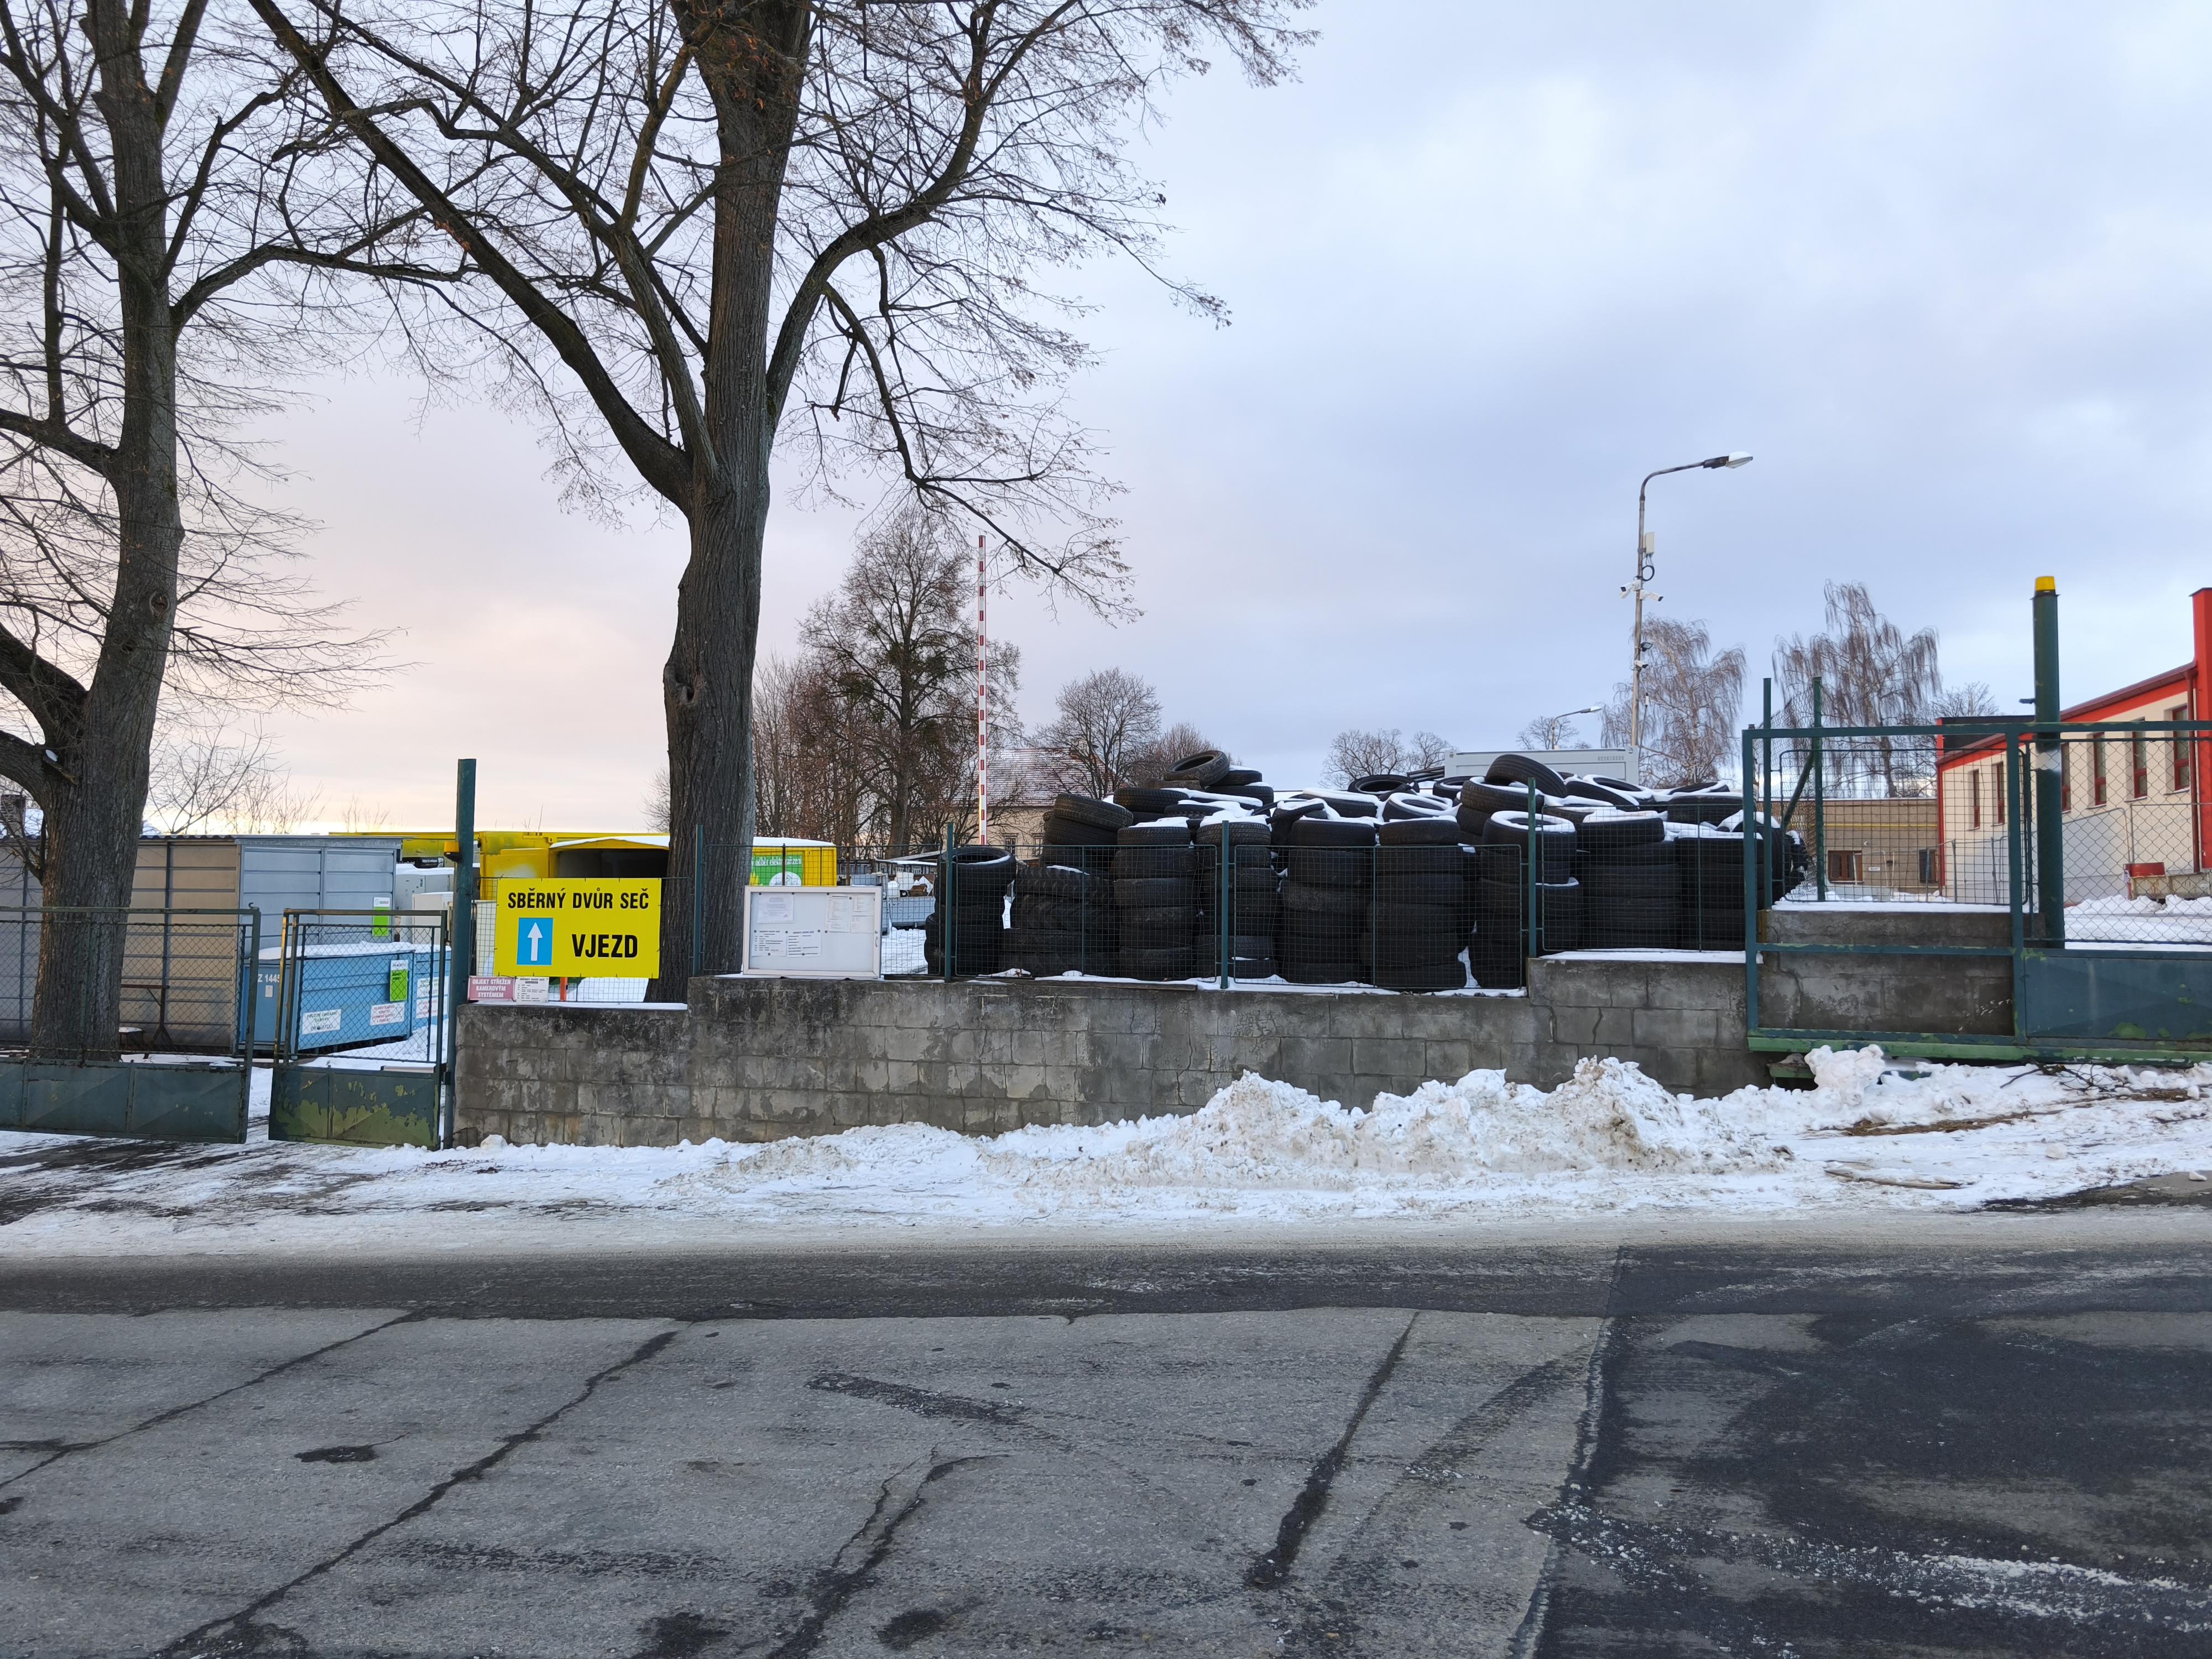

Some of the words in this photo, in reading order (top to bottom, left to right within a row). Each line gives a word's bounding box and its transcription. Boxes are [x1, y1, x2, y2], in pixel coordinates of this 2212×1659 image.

[508, 888, 566, 909] SBĚRNÝ
[572, 887, 613, 909] DVŮR
[620, 888, 649, 909] SEČ
[571, 933, 638, 958] VJEZD
